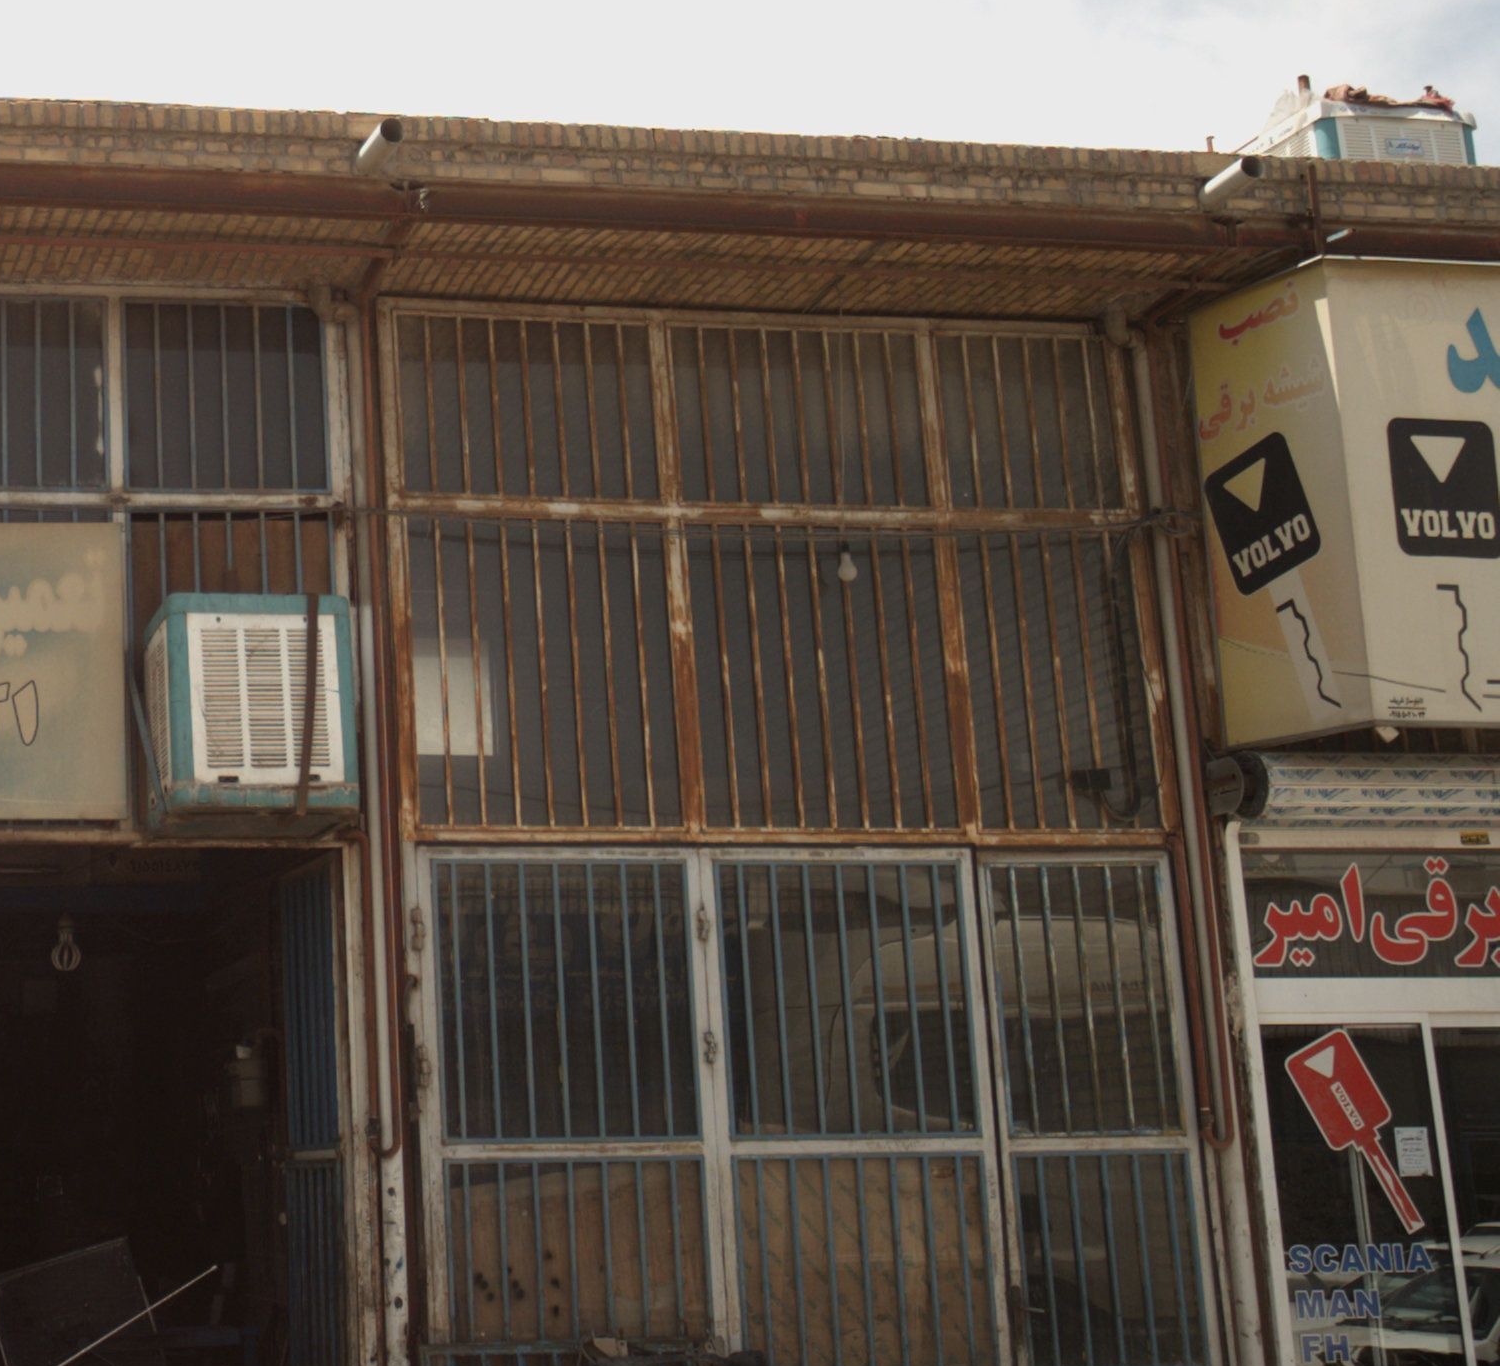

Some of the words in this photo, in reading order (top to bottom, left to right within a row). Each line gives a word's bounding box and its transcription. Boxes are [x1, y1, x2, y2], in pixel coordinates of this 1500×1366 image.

[1217, 280, 1299, 347] نصب
[1401, 508, 1496, 540] VOLVO
[1232, 513, 1311, 577] VOLVO
[1253, 862, 1364, 967] امیر
[1334, 1084, 1361, 1127] VOLVO
[1288, 1242, 1434, 1274] SCANIA
[1295, 1290, 1381, 1320] MAN
[1301, 1334, 1350, 1363] FH
